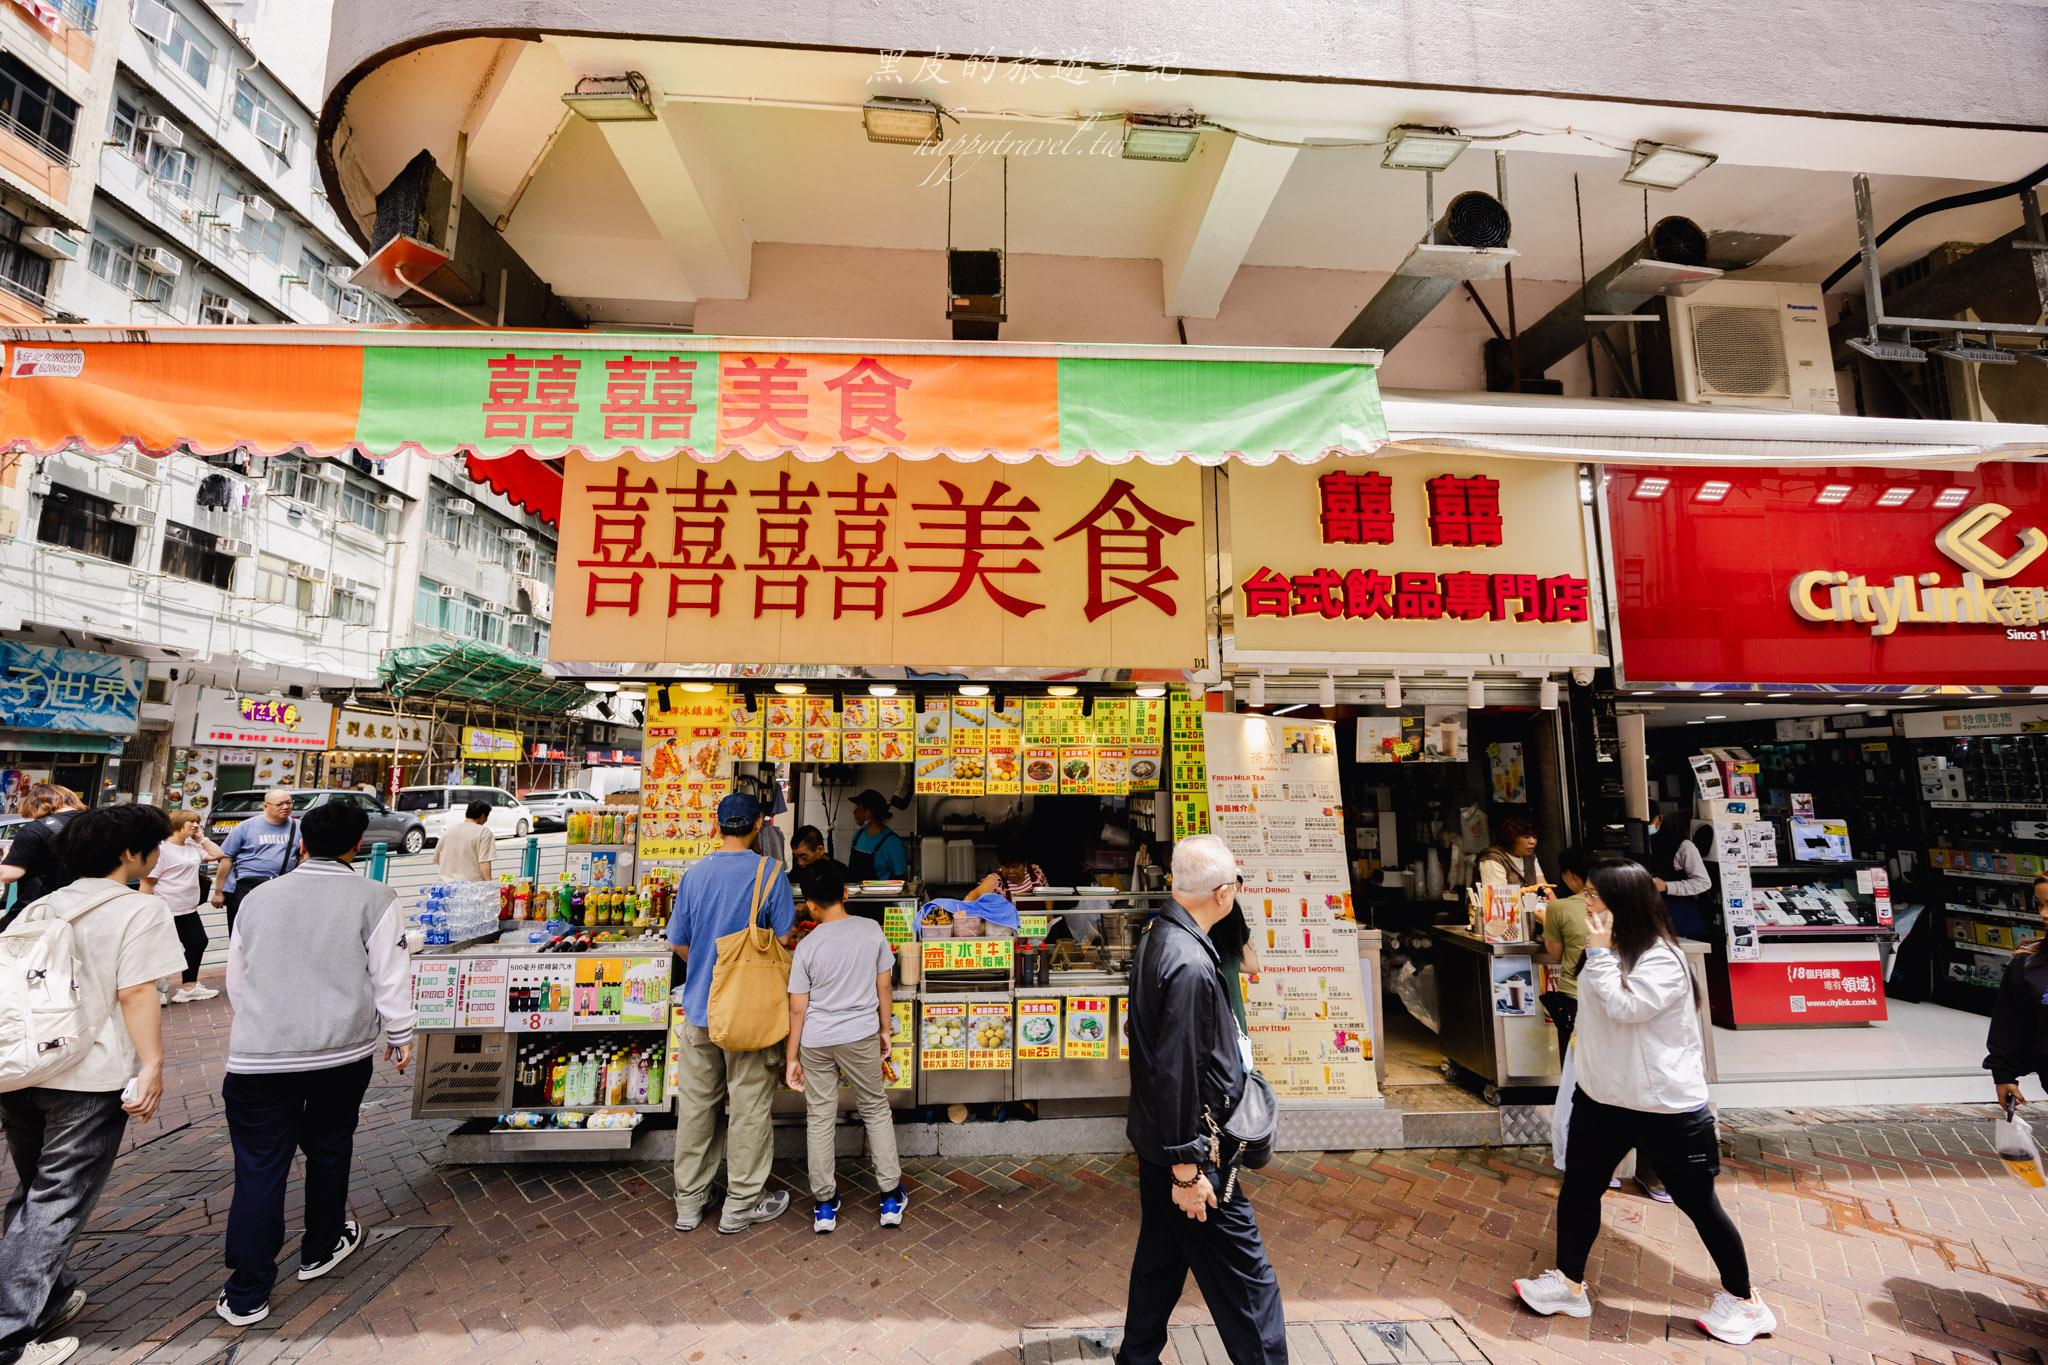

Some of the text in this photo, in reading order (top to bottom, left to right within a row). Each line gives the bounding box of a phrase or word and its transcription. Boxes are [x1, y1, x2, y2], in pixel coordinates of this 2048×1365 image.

[1241, 566, 1587, 623] 台式飲品專門店
[1790, 570, 2003, 636] CityLink
[2006, 629, 2037, 640] Since
[1194, 658, 1205, 668] D1
[1963, 723, 1990, 731] Special
[1215, 804, 1247, 812] 新品推介
[259, 834, 290, 845] BROOKLY
[652, 868, 668, 876] 10元
[510, 963, 573, 971] 500毫升膠樽裝汽水
[445, 966, 457, 1008] 每支8元
[1806, 998, 1878, 1008] www.citylink.com.hk
[1271, 1024, 1291, 1032] ITEMS
[1019, 1047, 1058, 1057] 每碗25元
